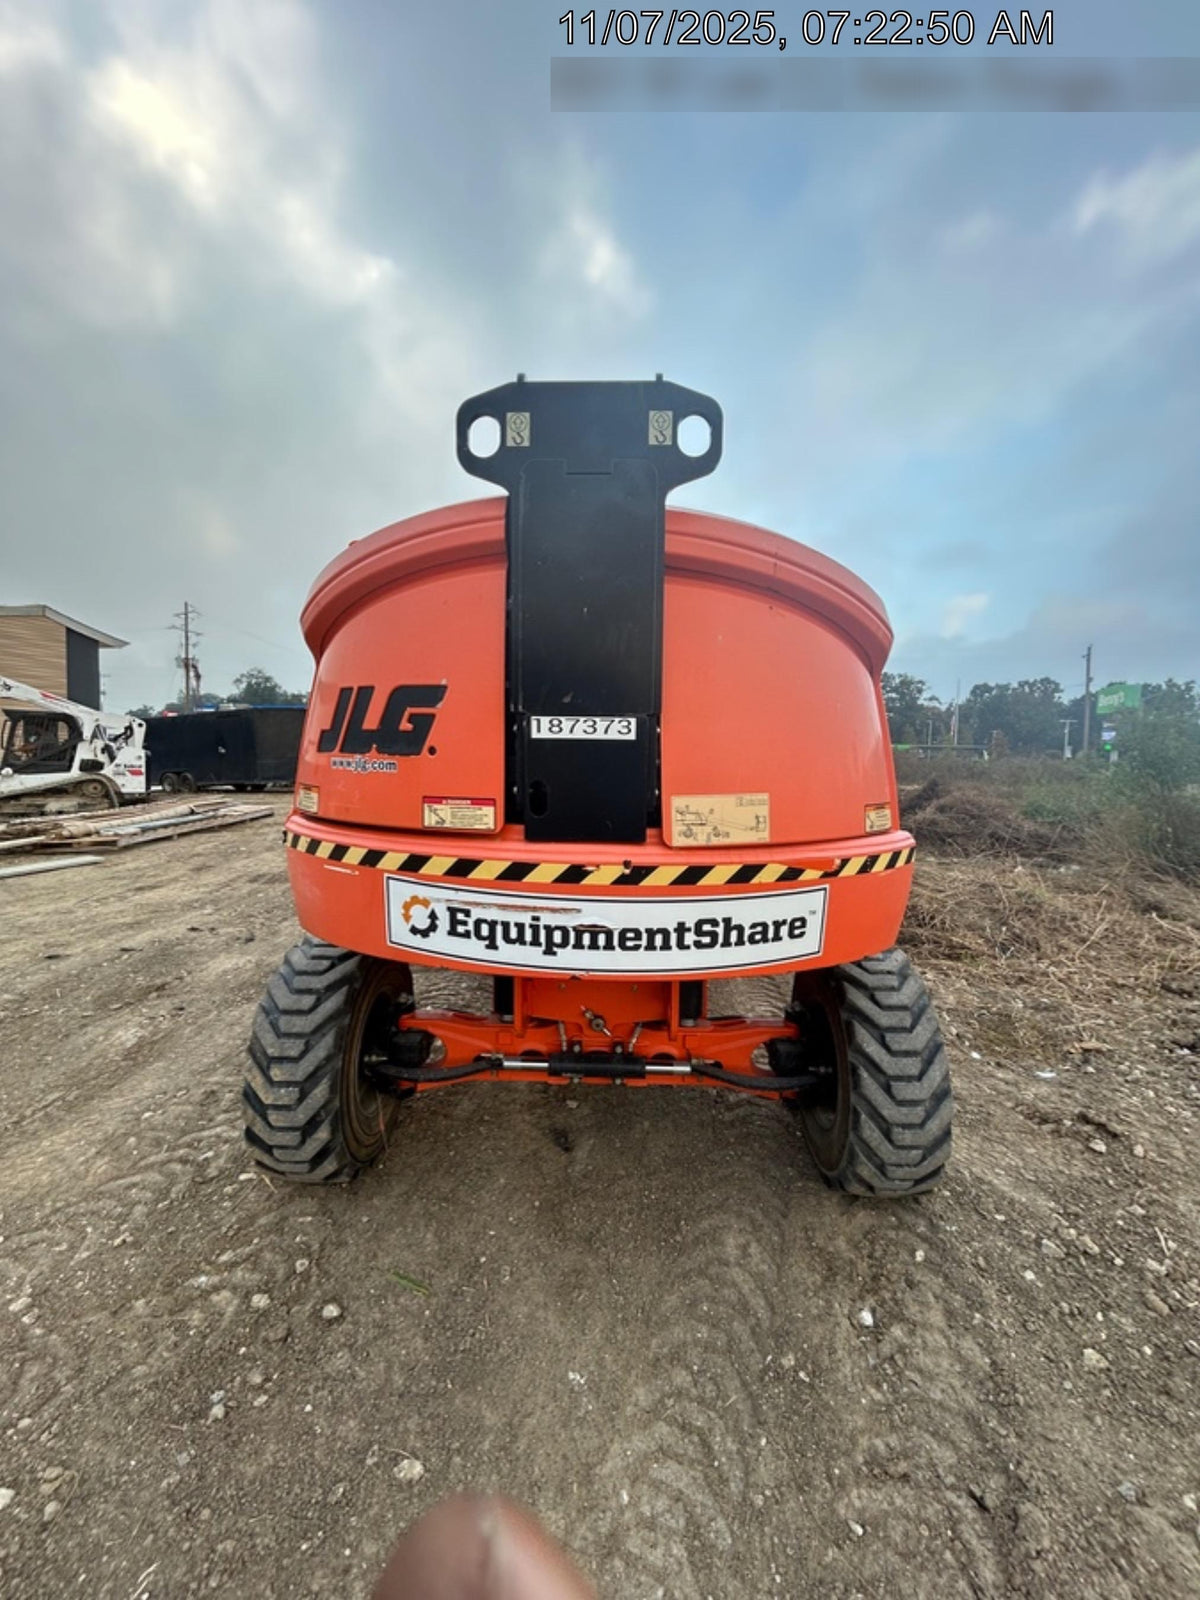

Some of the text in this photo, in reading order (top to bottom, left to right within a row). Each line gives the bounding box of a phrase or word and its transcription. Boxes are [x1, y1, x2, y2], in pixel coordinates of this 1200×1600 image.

[532, 717, 632, 735] 187373
[331, 757, 397, 773] www.jlg.com
[446, 906, 808, 956] EquipmentShare
